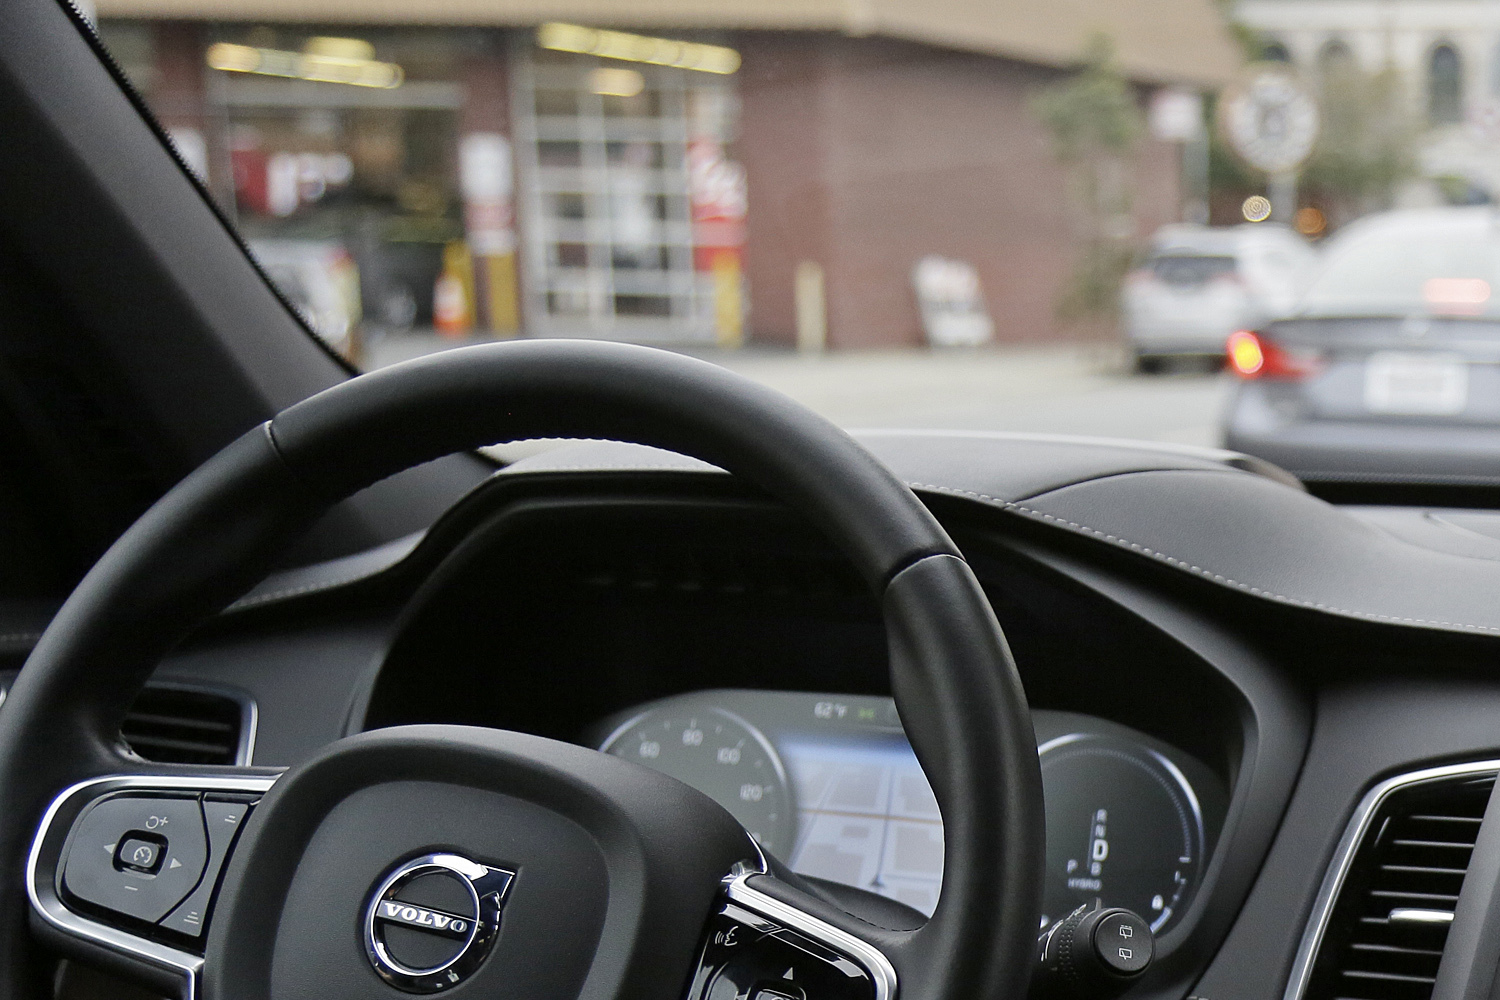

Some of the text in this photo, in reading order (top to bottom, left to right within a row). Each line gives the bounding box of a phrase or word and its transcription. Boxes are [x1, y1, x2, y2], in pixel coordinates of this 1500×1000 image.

[1095, 824, 1105, 837] N
[1093, 840, 1108, 860] D
[1067, 859, 1078, 873] P
[384, 902, 468, 934] VOLVO
